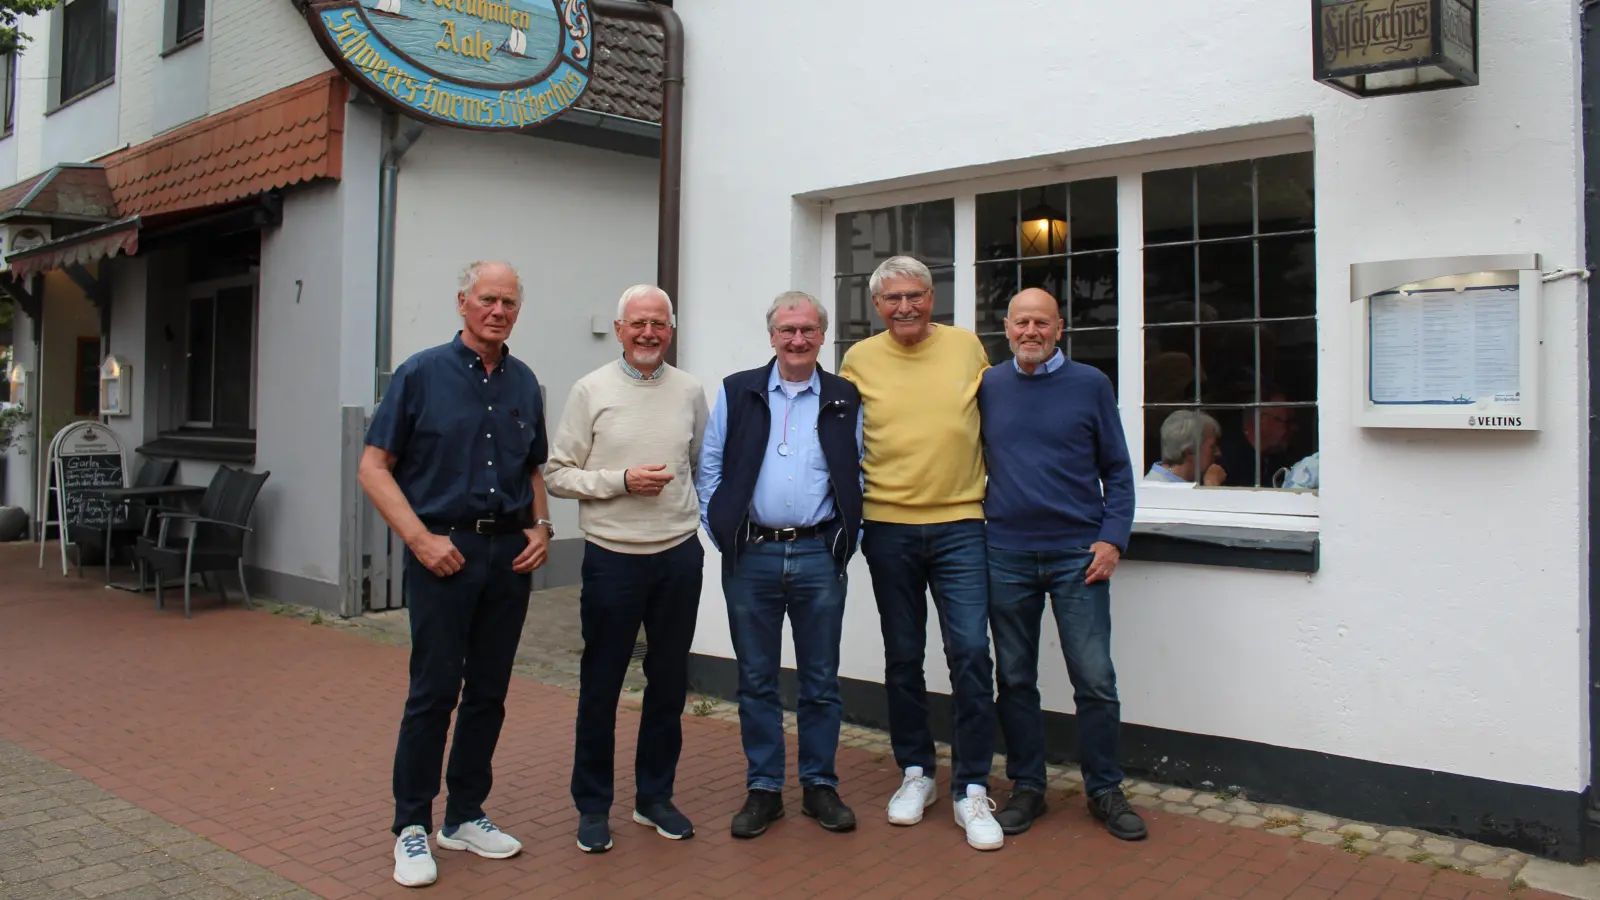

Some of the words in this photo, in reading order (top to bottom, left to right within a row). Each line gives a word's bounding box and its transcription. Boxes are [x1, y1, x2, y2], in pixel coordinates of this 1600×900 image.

[435, 19, 493, 62] Aale
[1324, 1, 1429, 63] Fischerhus
[295, 279, 303, 304] 7
[1477, 416, 1522, 427] VELTINS
